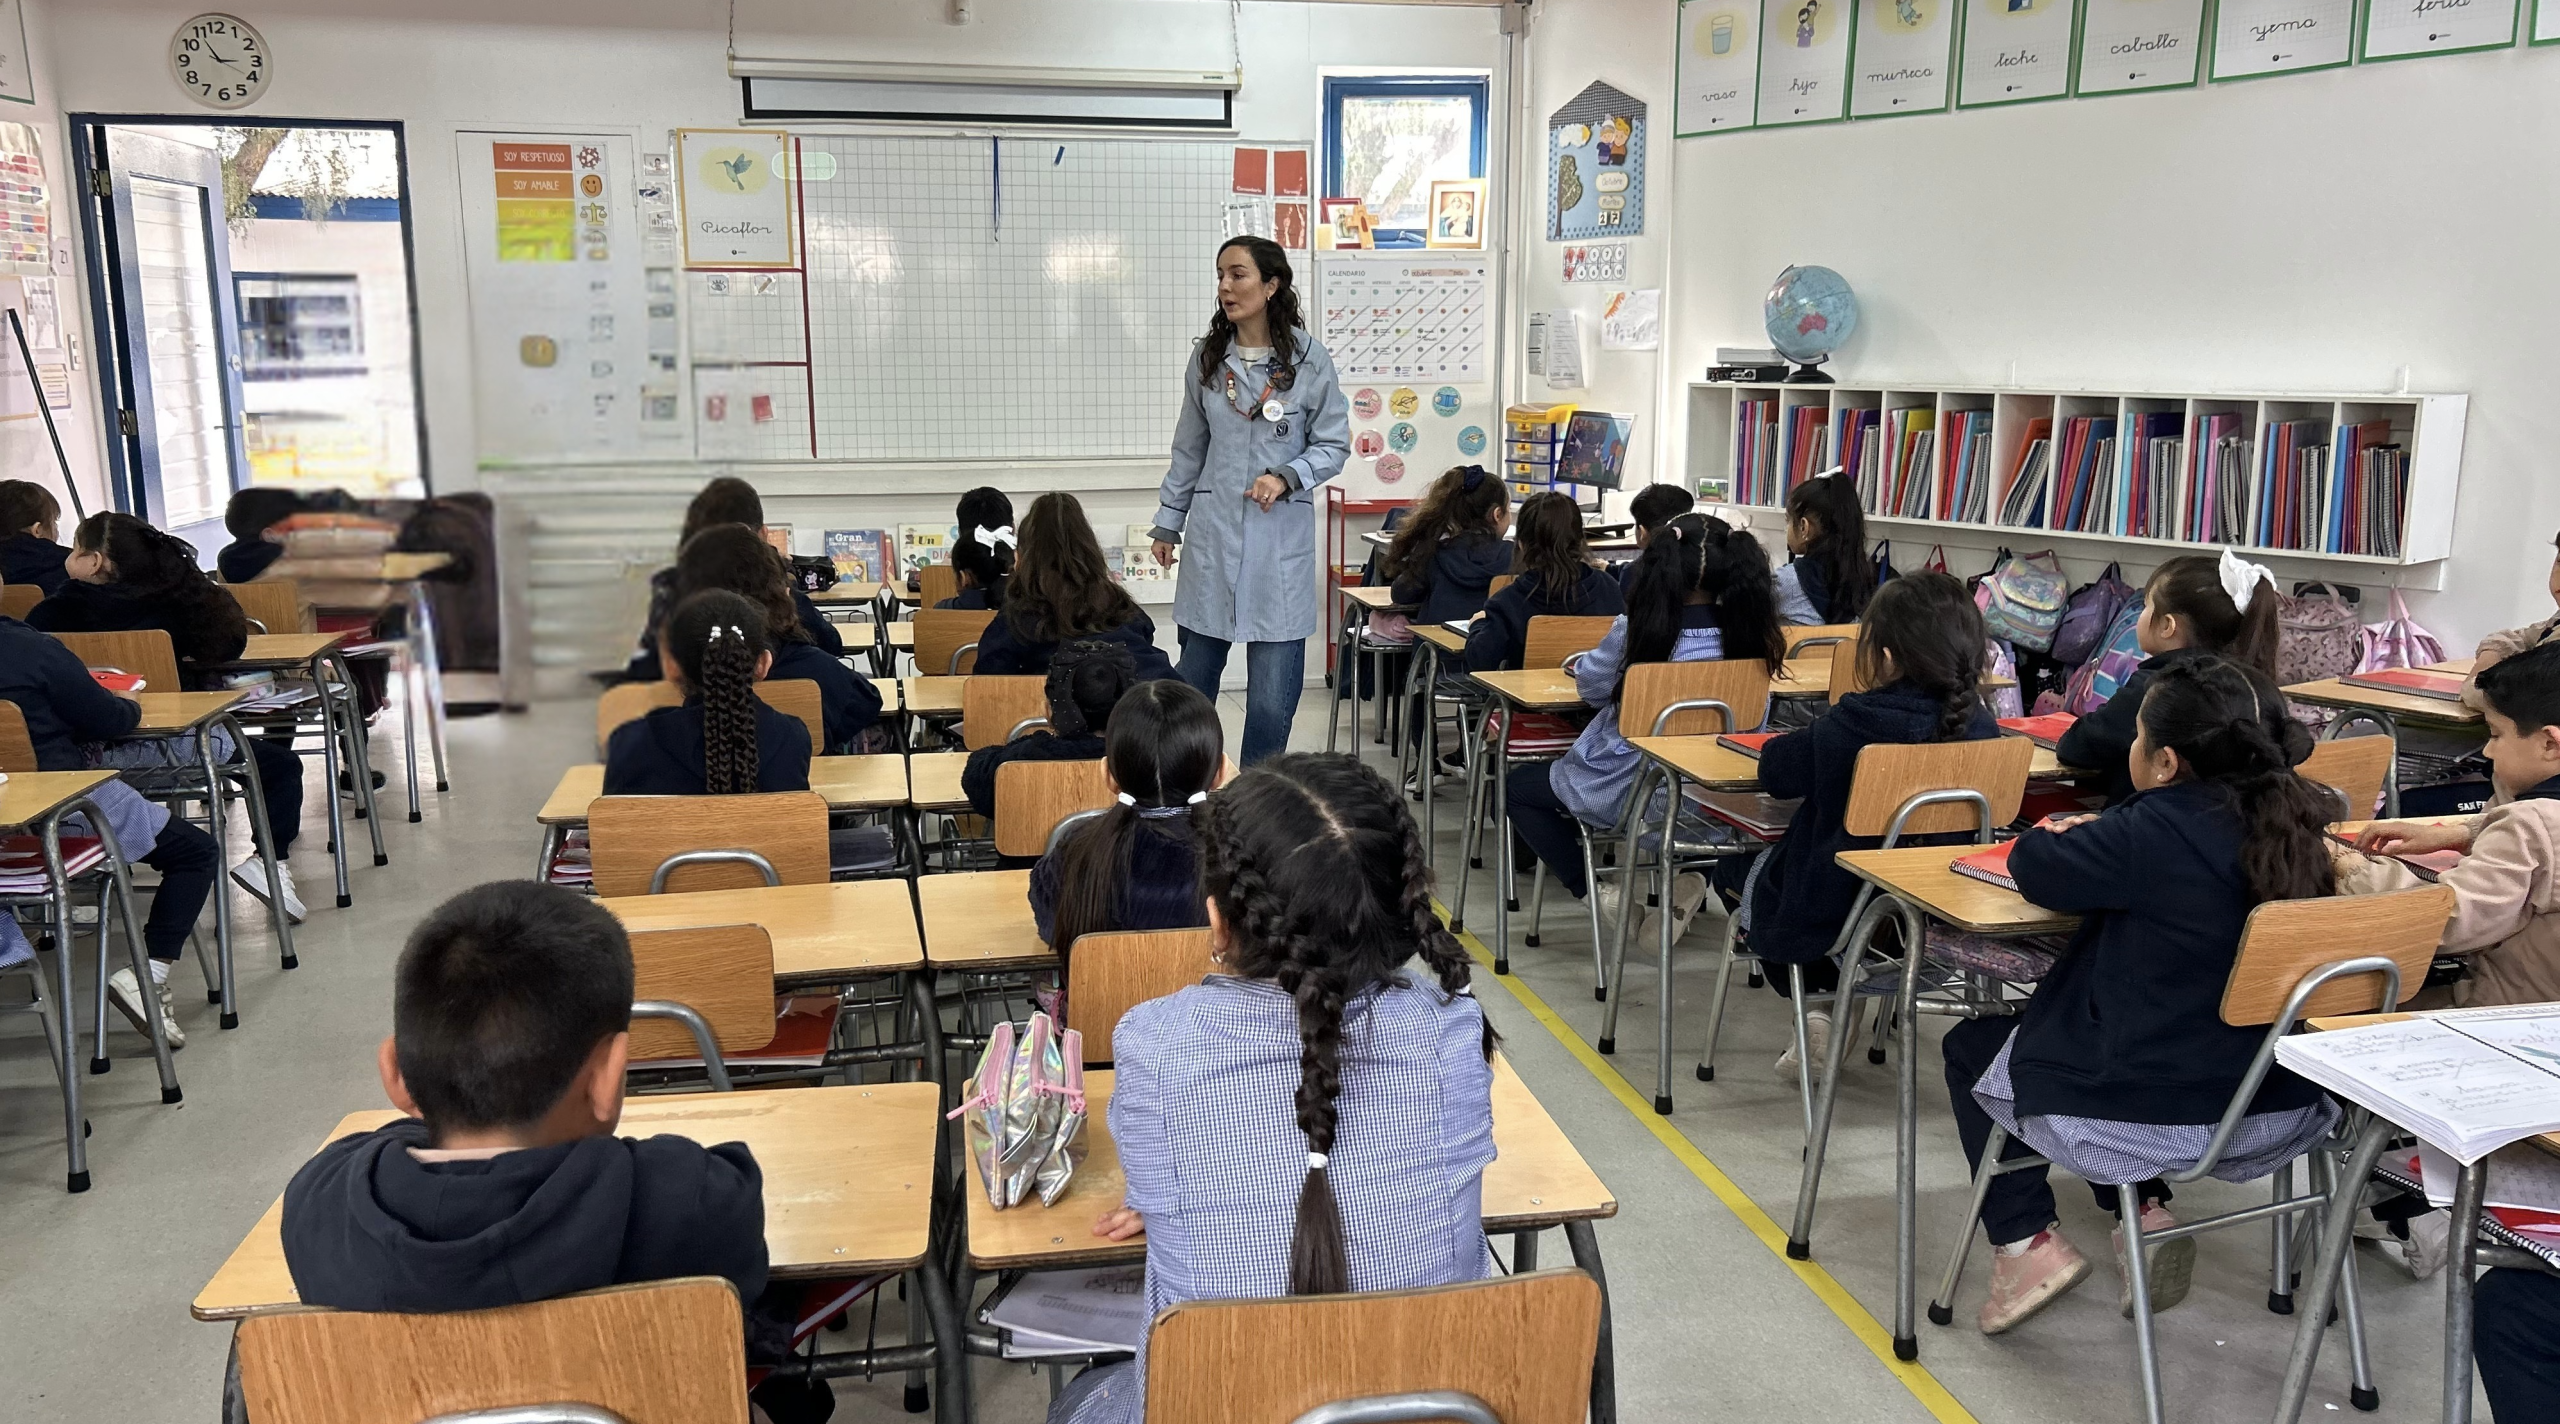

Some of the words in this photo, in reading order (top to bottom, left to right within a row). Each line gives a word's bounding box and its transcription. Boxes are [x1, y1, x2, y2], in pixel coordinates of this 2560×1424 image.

[192, 26, 207, 38] 11
[206, 21, 226, 35] 12
[231, 26, 238, 38] 1
[2250, 16, 2317, 41] yema
[182, 38, 200, 51] 10
[243, 38, 254, 50] 2
[2110, 34, 2179, 54] caballo
[178, 54, 190, 67] 9
[250, 55, 262, 67] 3
[1994, 51, 2038, 68] leche
[186, 71, 199, 84] 8
[246, 70, 258, 83] 4
[1866, 66, 1933, 83] muñeca
[202, 84, 211, 96] 7
[218, 88, 230, 101] 6
[236, 84, 247, 96] 5
[1701, 88, 1737, 103] vaso
[503, 151, 517, 162] SOY
[520, 152, 565, 163] RESPETUOSO
[513, 180, 527, 191] SOY
[531, 180, 559, 191] AMABLE
[1600, 214, 1606, 223] 2
[1611, 212, 1618, 223] 7
[701, 221, 772, 238] Picaflor
[835, 533, 862, 542] Gran
[918, 536, 935, 545] Un
[1126, 567, 1157, 576] Hora
[2457, 801, 2476, 811] SAN
